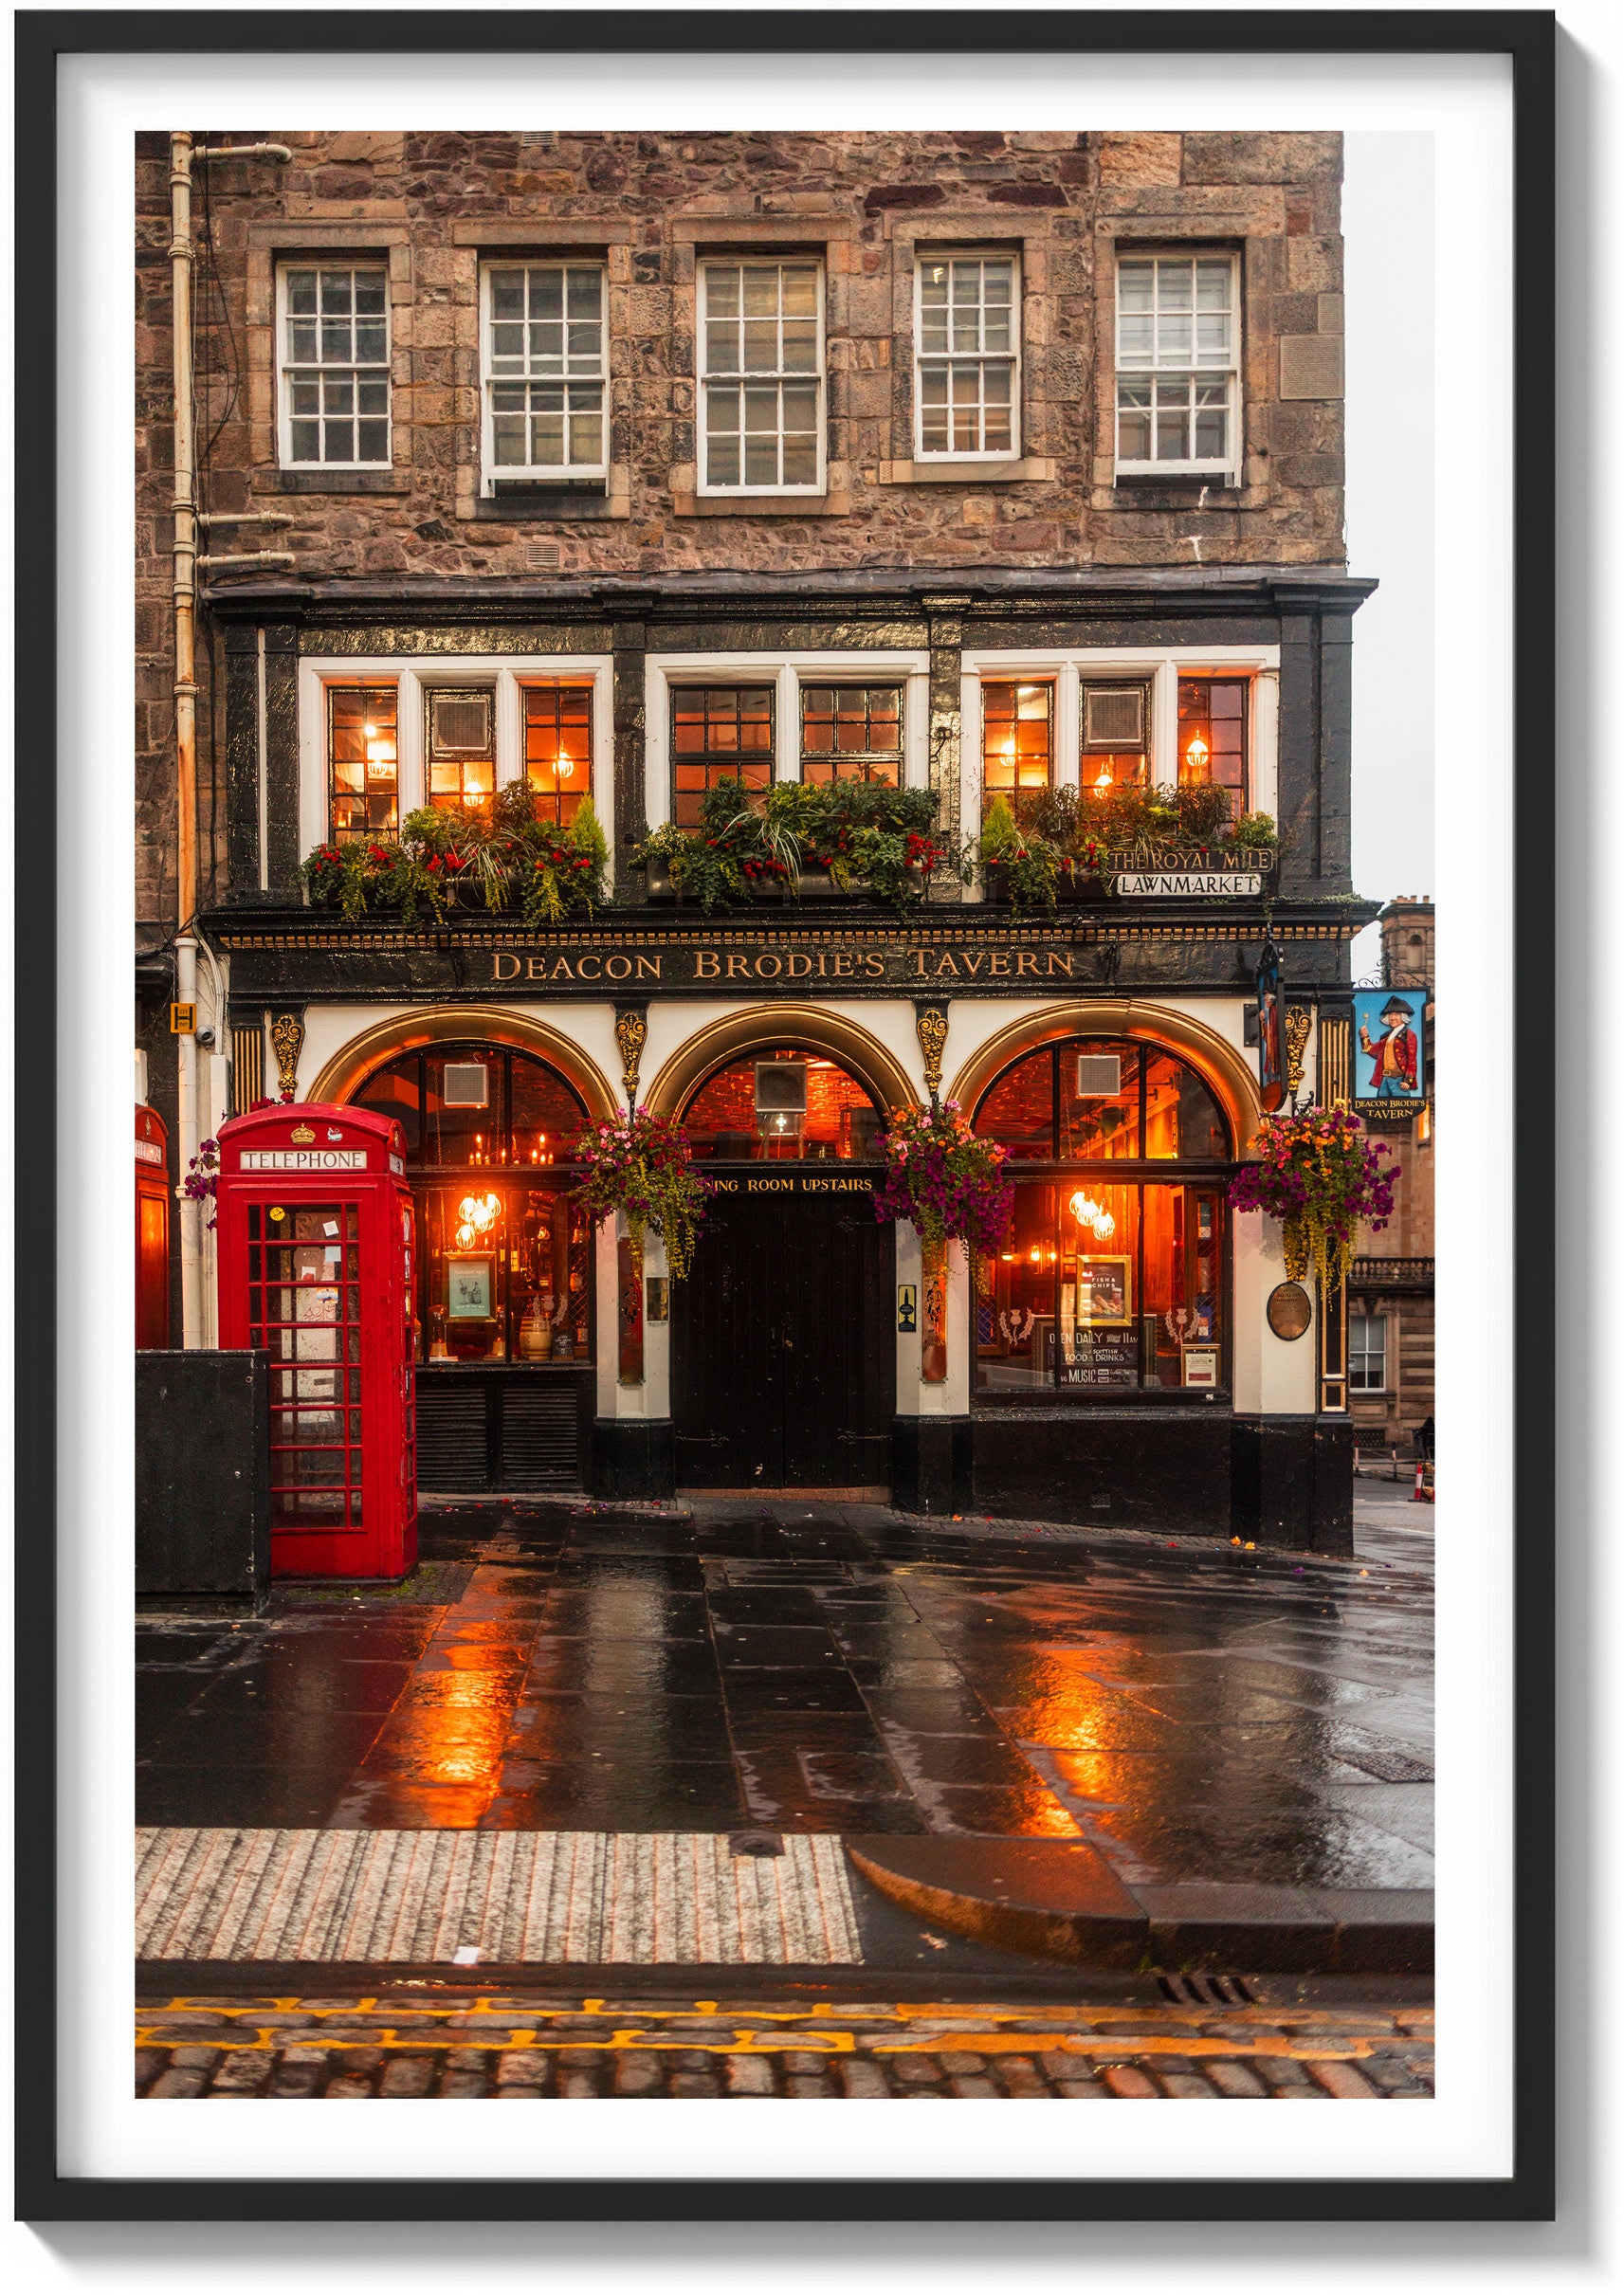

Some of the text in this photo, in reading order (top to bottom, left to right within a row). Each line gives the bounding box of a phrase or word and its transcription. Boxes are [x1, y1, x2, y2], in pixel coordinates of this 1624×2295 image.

[1110, 853, 1268, 869] THE ROYAL MILE
[1122, 876, 1255, 893] LAWNMARKET
[490, 949, 1074, 980] DEACON BRODIE'S TAVERN
[1355, 1100, 1388, 1108] DEACON
[1366, 1109, 1414, 1119] TAVERN
[245, 1152, 362, 1169] TELEPHONE
[748, 1179, 794, 1191] ROOM
[802, 1179, 872, 1191] UPSTAIRS
[1049, 1333, 1072, 1344] OEN
[1076, 1332, 1104, 1344] DAILY
[1065, 1354, 1088, 1362] FOOD
[1095, 1354, 1124, 1362] DRINKS
[1068, 1369, 1097, 1383] MUSIC
